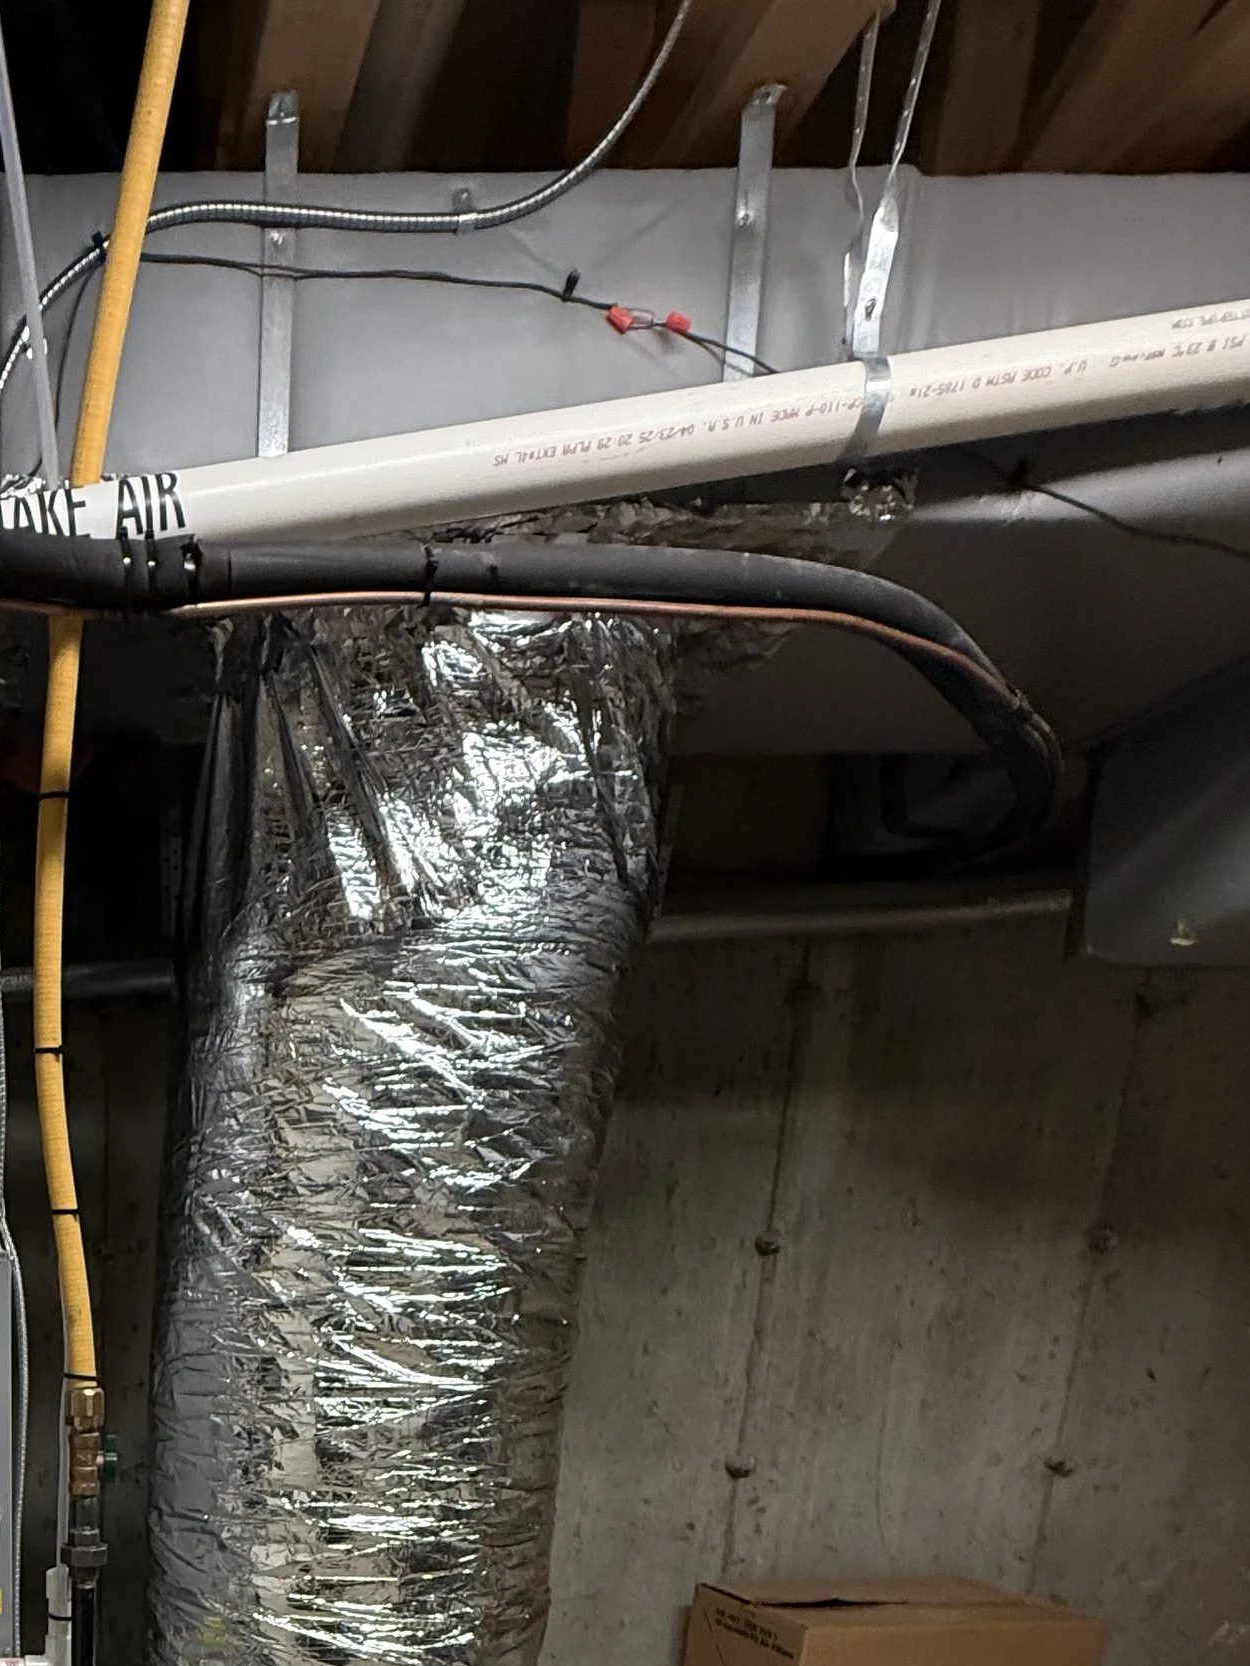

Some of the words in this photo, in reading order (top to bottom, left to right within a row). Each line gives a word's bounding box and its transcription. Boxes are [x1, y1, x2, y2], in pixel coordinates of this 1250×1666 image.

[987, 371, 1018, 387] ASTM
[1021, 366, 1052, 381] CODE
[972, 376, 982, 388] D
[749, 412, 764, 425] IN
[771, 406, 800, 422] MADE
[638, 424, 695, 443] 04/23/25
[561, 440, 592, 455] PLPA
[117, 472, 186, 539] AIR
